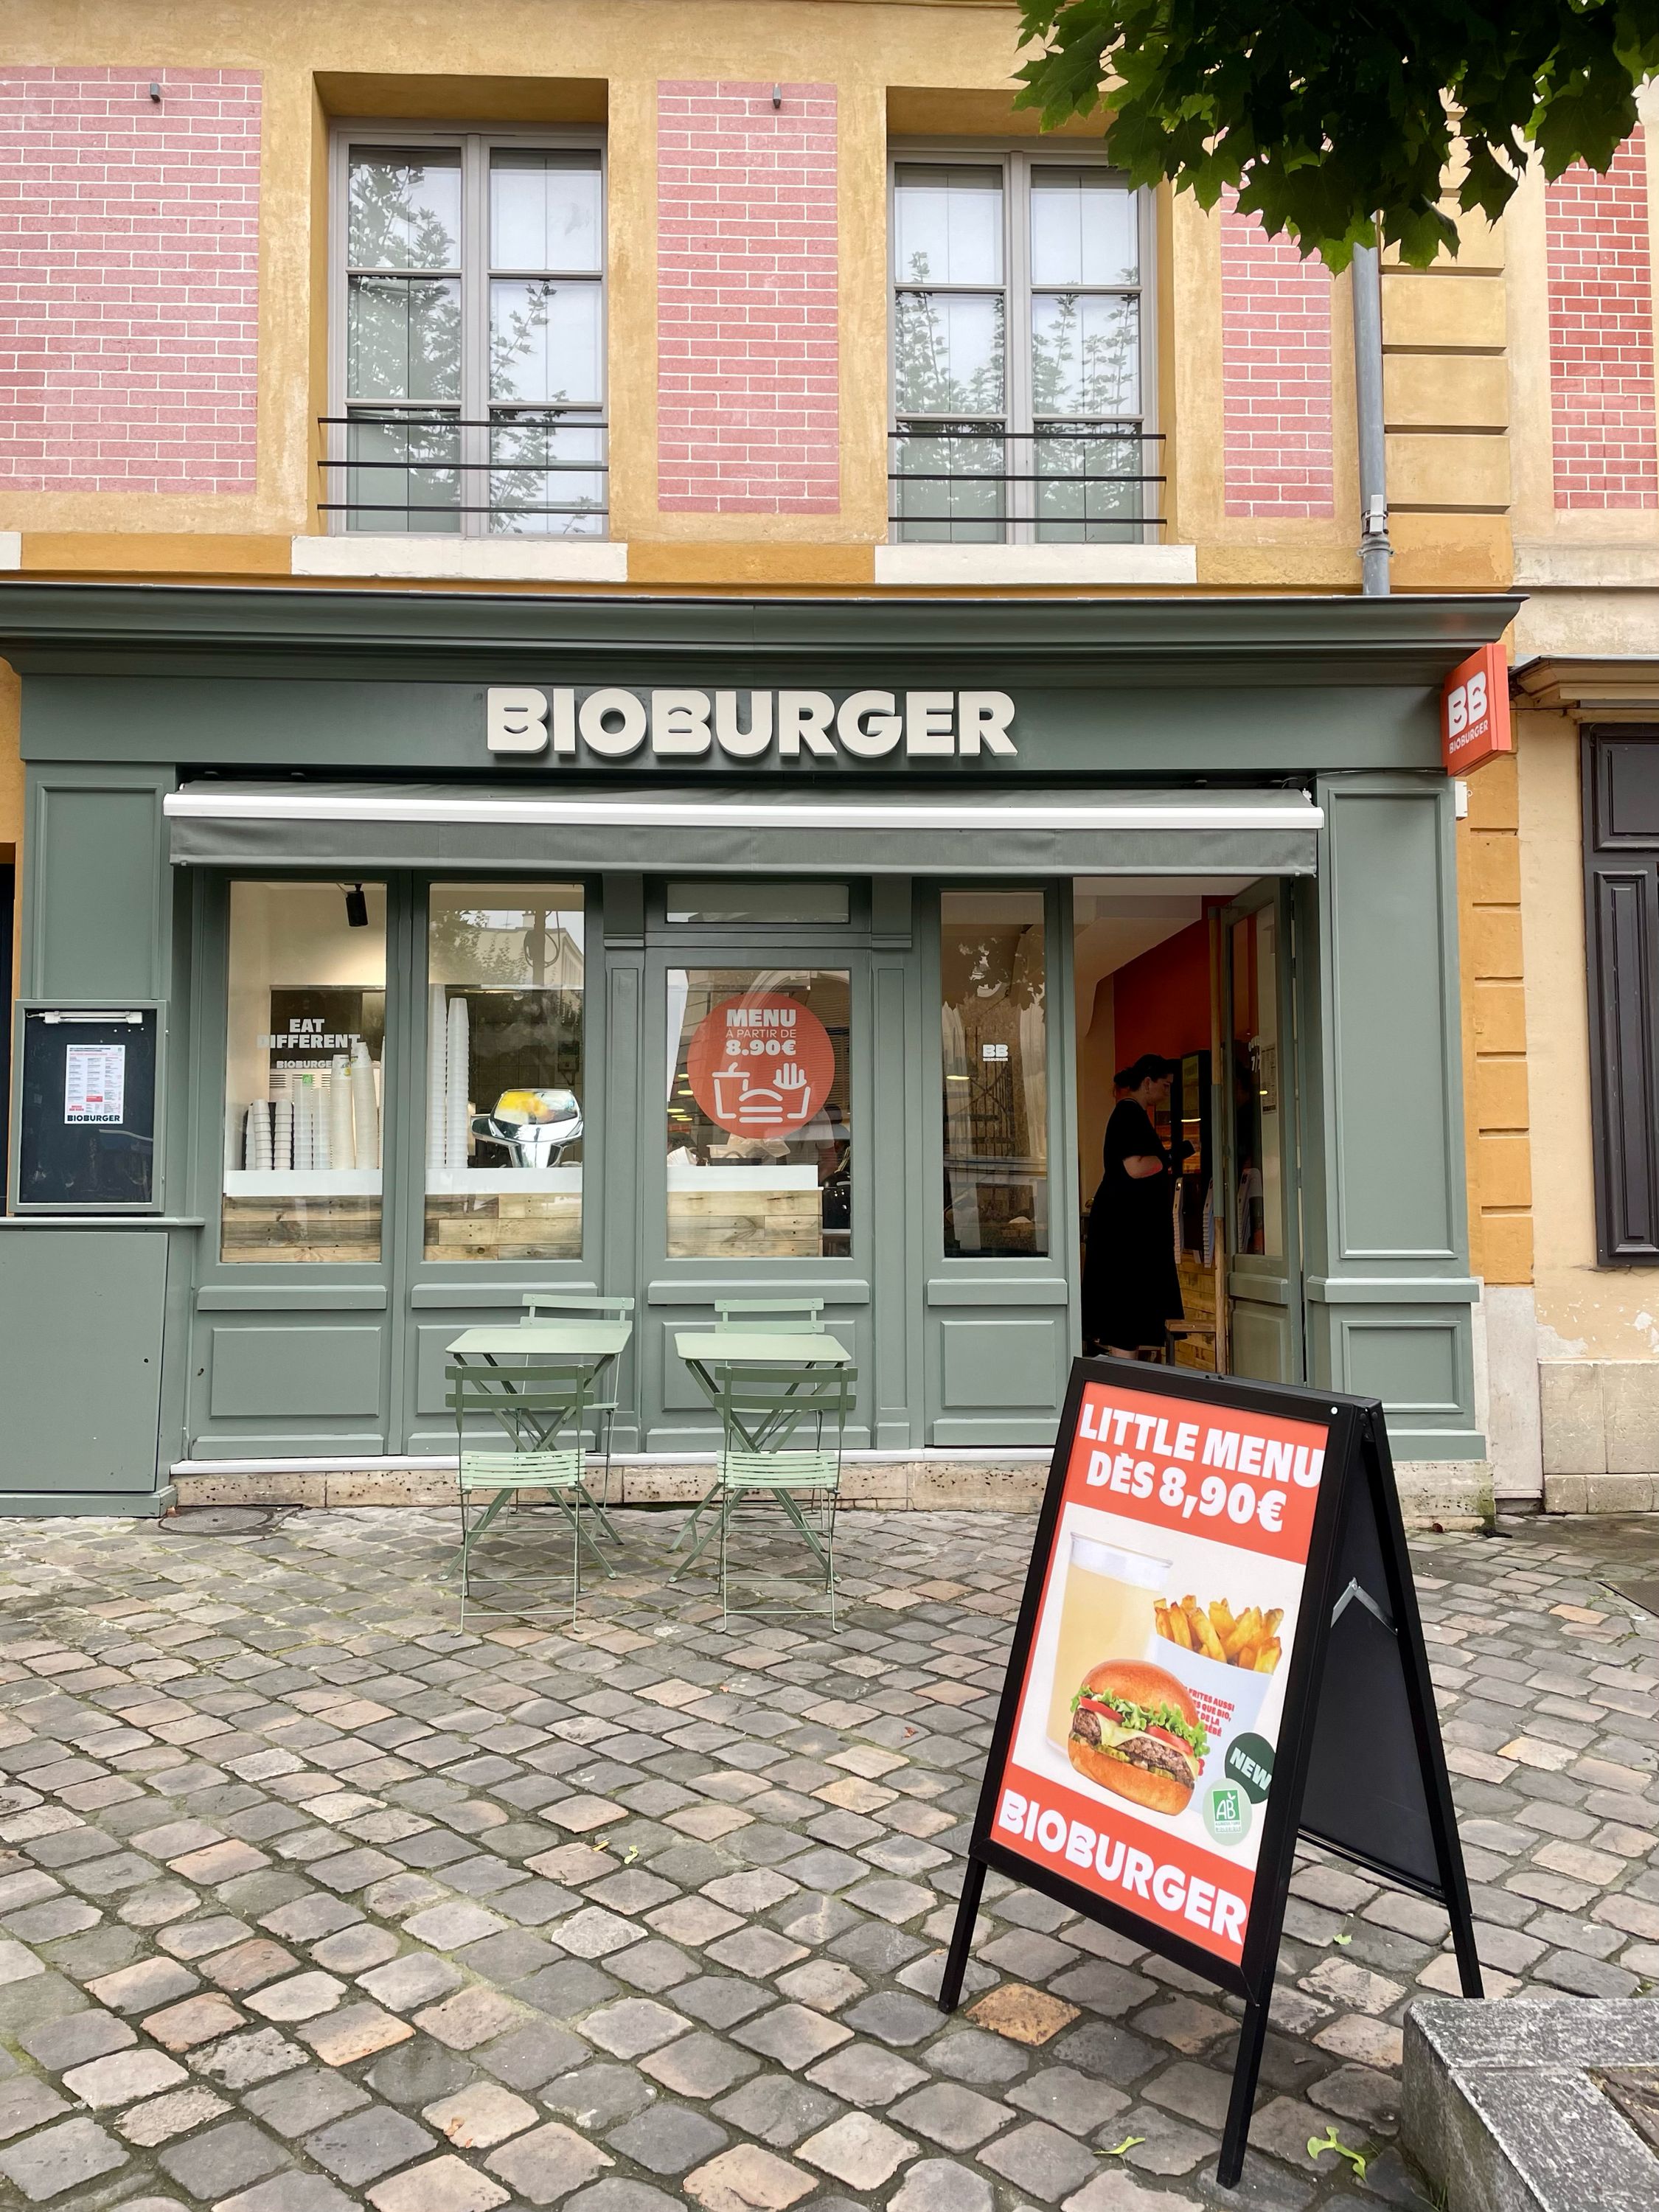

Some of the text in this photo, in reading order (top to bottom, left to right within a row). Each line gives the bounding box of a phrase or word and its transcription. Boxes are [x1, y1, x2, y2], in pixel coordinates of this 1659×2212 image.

[1448, 672, 1487, 738] BB
[487, 687, 1018, 758] BIOBURGER
[1449, 720, 1488, 754] BIOBURGER
[289, 1018, 324, 1032] EAT
[726, 1009, 796, 1027] MENU
[257, 1034, 361, 1048] DIFFERENT
[726, 1028, 796, 1038] À PARTIR DE
[726, 1040, 796, 1056] 8.90€
[983, 1044, 1008, 1057] BB
[276, 1060, 333, 1068] BIOBURGE
[1079, 1404, 1325, 1488] LITTLE MENU
[1086, 1450, 1287, 1532] DÈS 8,90€
[1202, 1703, 1216, 1715] QUE
[1217, 1709, 1231, 1722] BIO,
[1214, 1698, 1234, 1711] AUSSI
[1200, 1713, 1209, 1722] DE
[1211, 1715, 1220, 1725] LA
[1230, 1747, 1272, 1791] NEW
[1217, 1800, 1236, 1820] AB
[998, 1788, 1247, 1946] BIOBURGER
